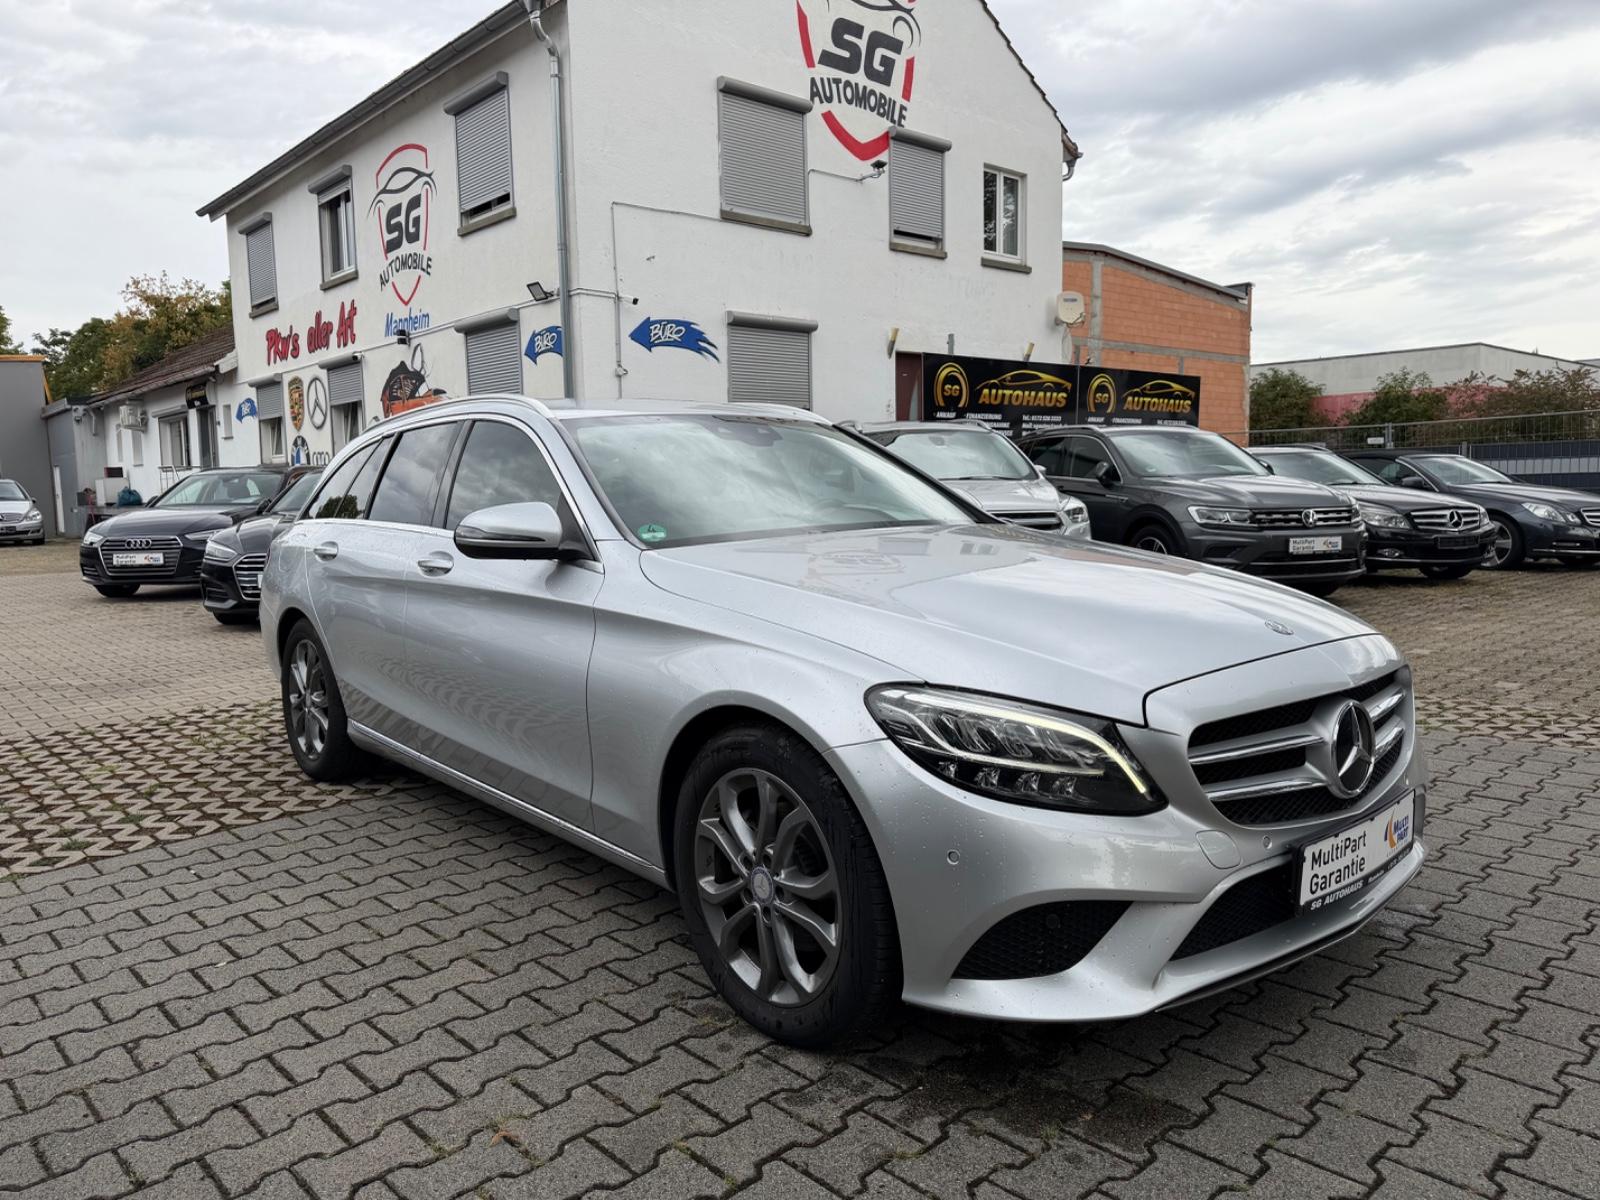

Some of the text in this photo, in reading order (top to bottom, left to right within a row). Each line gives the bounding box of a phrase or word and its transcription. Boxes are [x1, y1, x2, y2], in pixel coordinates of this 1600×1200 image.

[817, 17, 904, 87] SG
[810, 76, 908, 128] AUTOMOBILE
[385, 193, 422, 254] SG
[379, 252, 432, 292] AUTOMOBILE
[307, 310, 333, 354] aller
[336, 299, 357, 349] Art
[384, 306, 430, 338] Mannheim
[943, 385, 960, 396] SG
[978, 388, 1068, 408] AUTOHAUS
[1095, 393, 1109, 404] SG
[1123, 396, 1192, 413] AUTOHAUS
[1310, 830, 1367, 871] MultiPart
[1309, 855, 1366, 895] Garantie
